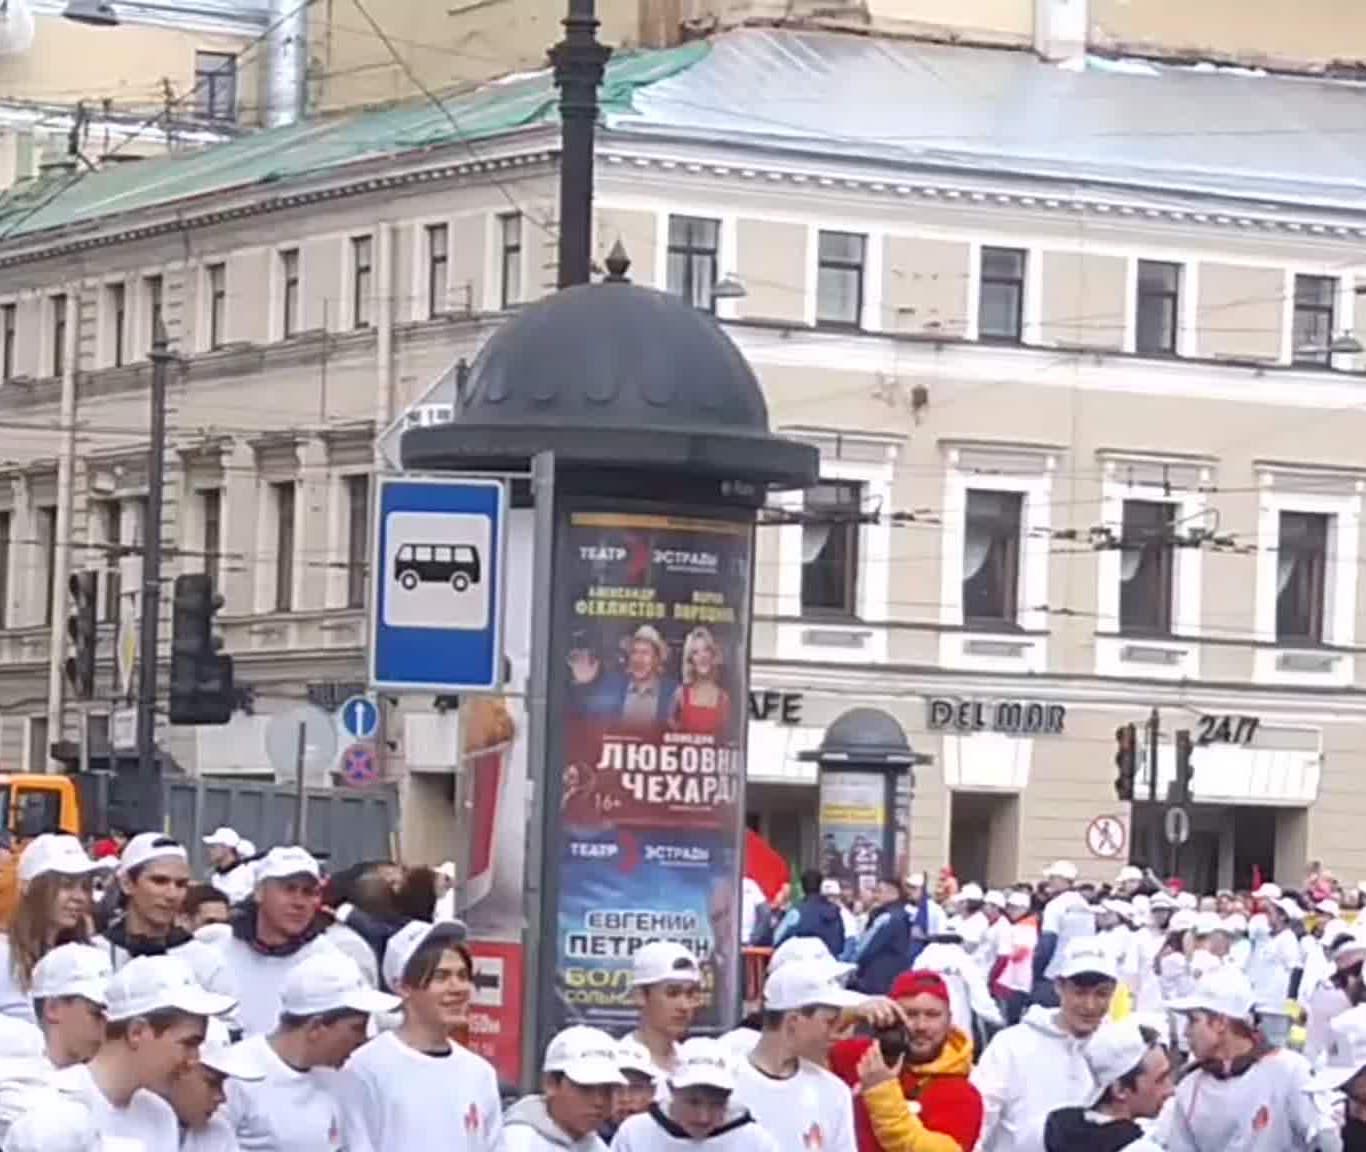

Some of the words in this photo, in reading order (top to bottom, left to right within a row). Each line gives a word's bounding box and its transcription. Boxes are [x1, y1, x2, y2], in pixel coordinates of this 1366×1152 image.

[579, 547, 627, 560] ТЕАТР
[930, 699, 986, 730] DEL
[996, 700, 1066, 733] MAR
[1197, 714, 1260, 746] 24/7
[570, 842, 619, 857] ТЕАТР
[588, 911, 698, 932] ЕВГЕНИЙ
[569, 934, 709, 956] ПЕТРЯН
